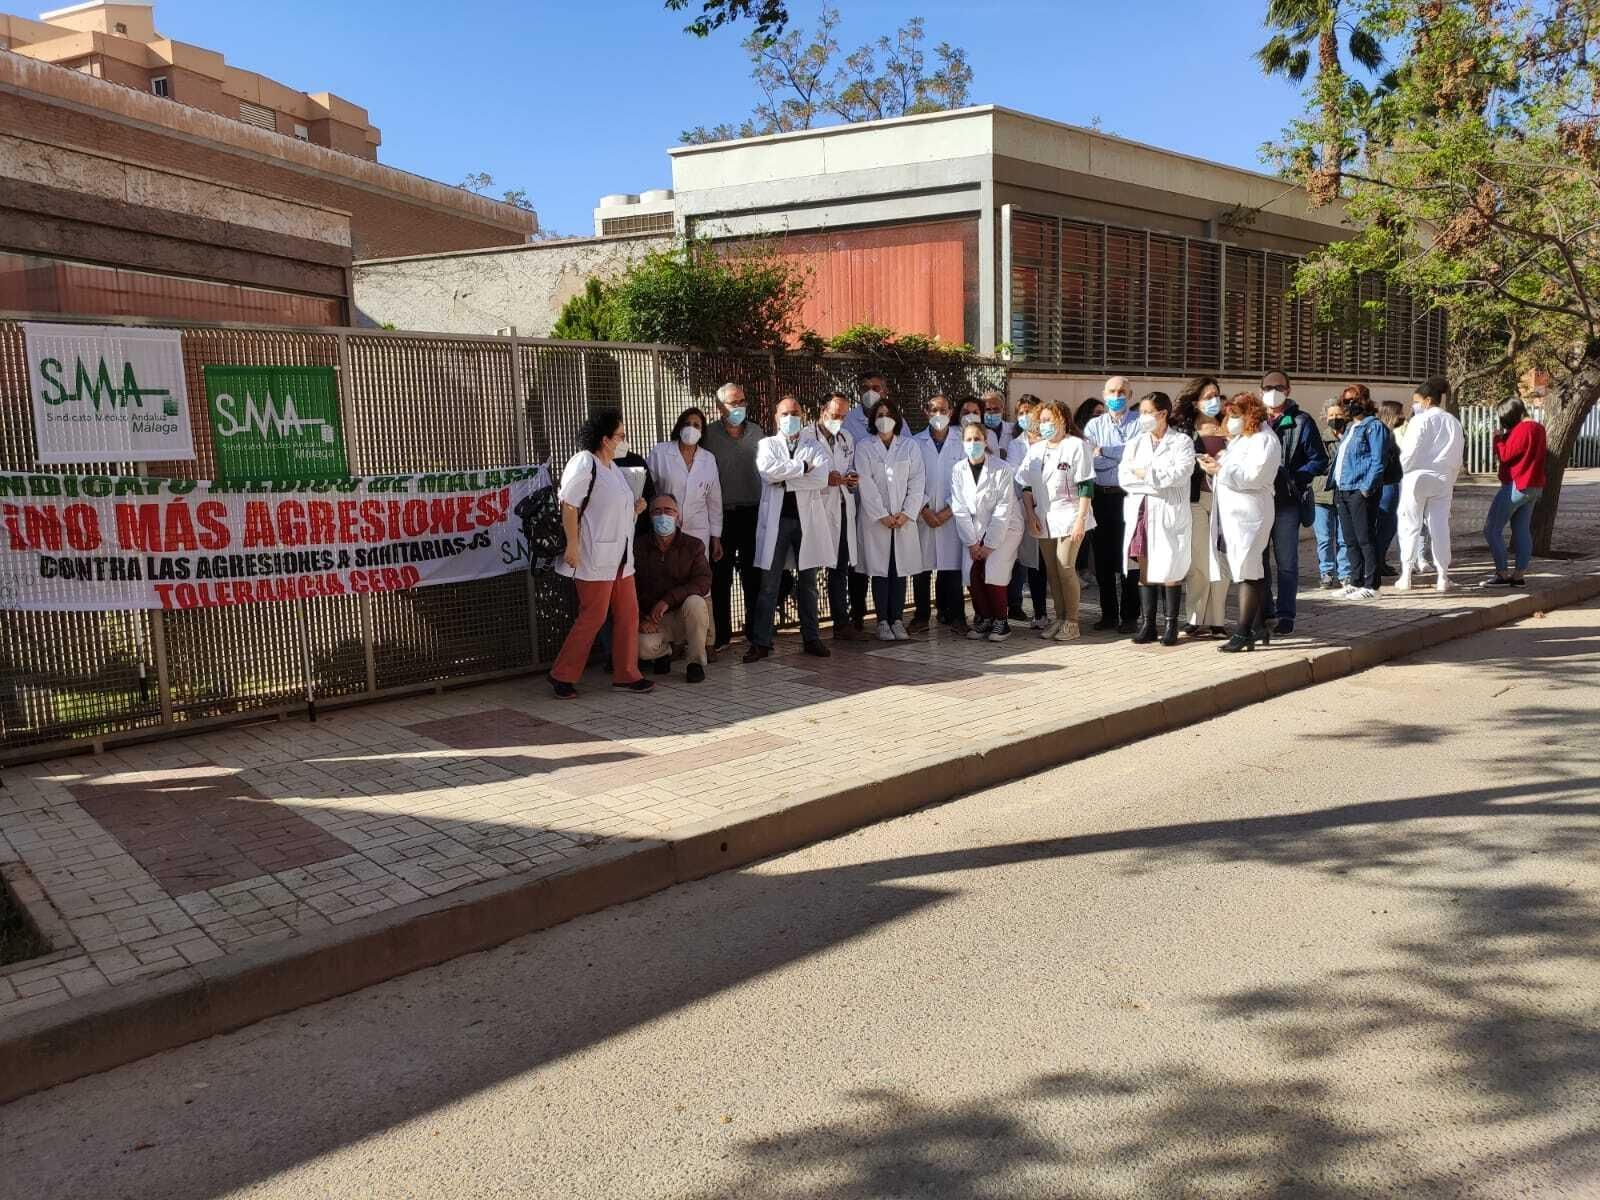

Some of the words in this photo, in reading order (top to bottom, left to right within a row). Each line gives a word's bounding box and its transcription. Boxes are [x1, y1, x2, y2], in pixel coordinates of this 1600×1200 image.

[114, 496, 231, 552] MÁS
[243, 487, 512, 549] AGRESIONES!
[40, 555, 143, 581] CONTRA
[147, 556, 191, 580] LAS
[195, 549, 335, 580] AGRESIONES
[336, 552, 351, 570] A
[154, 574, 346, 610] TOLERANCIA
[349, 565, 421, 594] CERO
